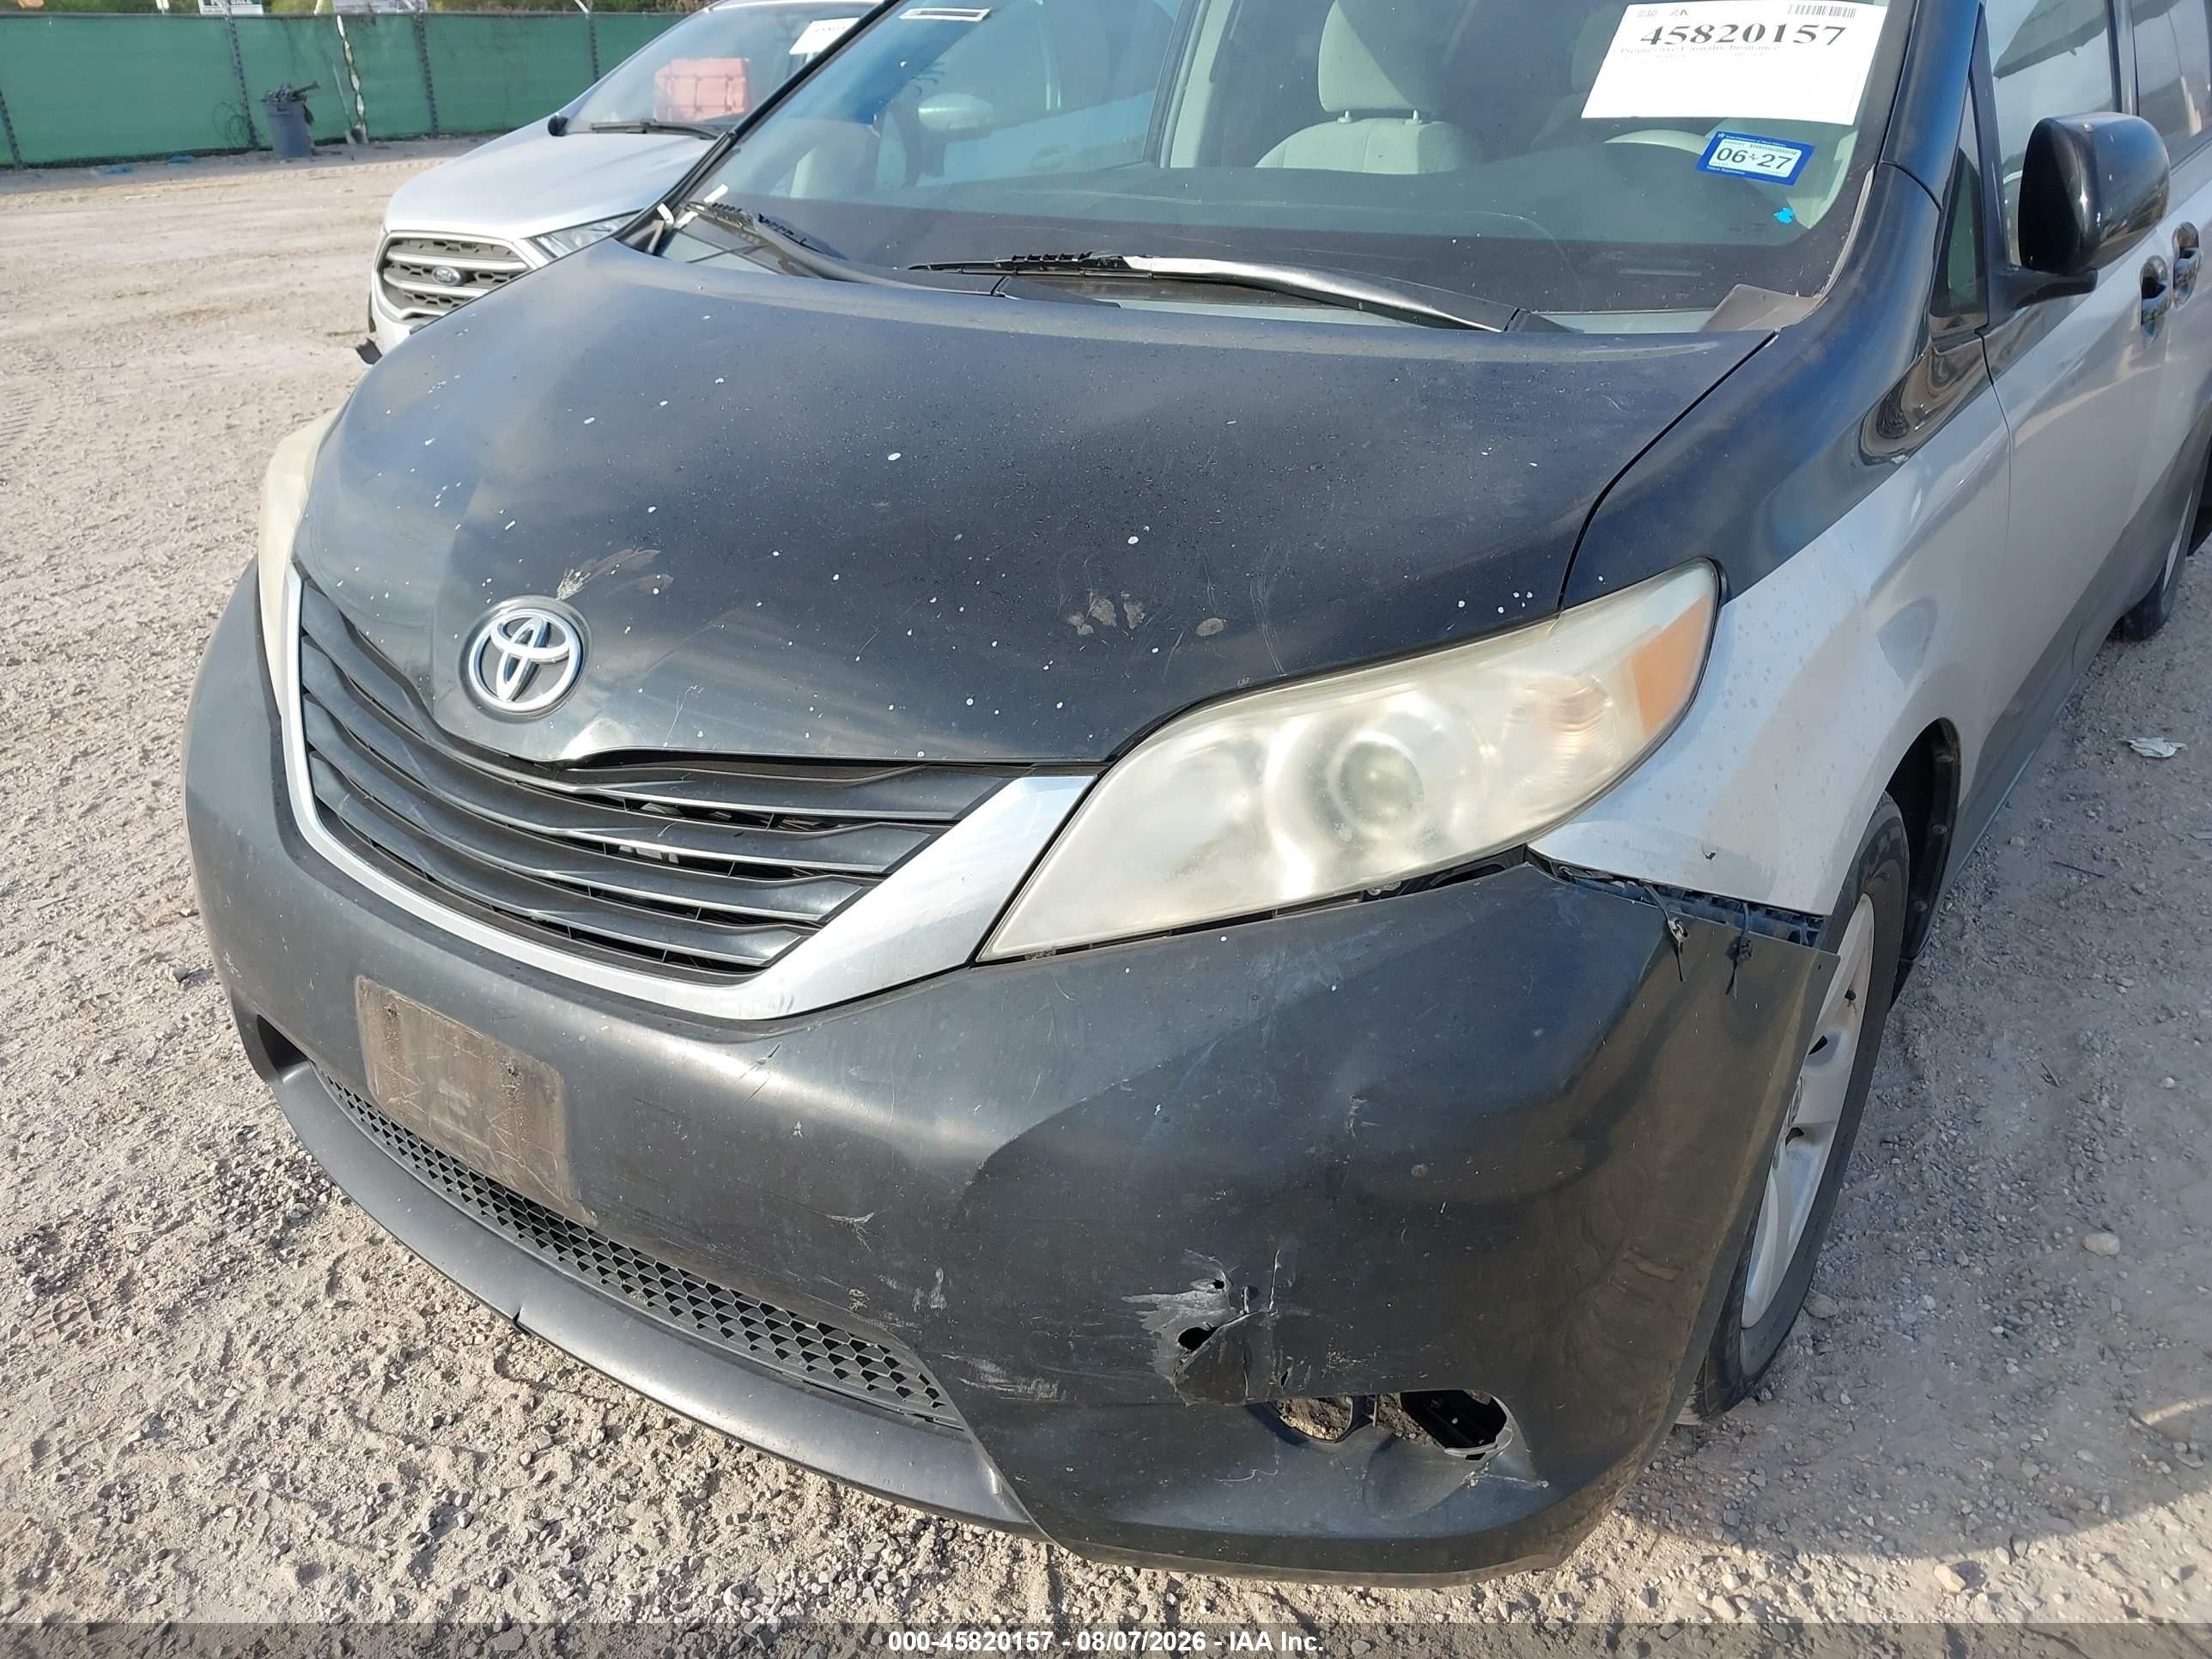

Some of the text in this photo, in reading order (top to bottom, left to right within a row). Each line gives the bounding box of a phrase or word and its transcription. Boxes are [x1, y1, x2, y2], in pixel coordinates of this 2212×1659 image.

[1640, 22, 1847, 46] 45820157
[1716, 147, 1793, 169] 06 27
